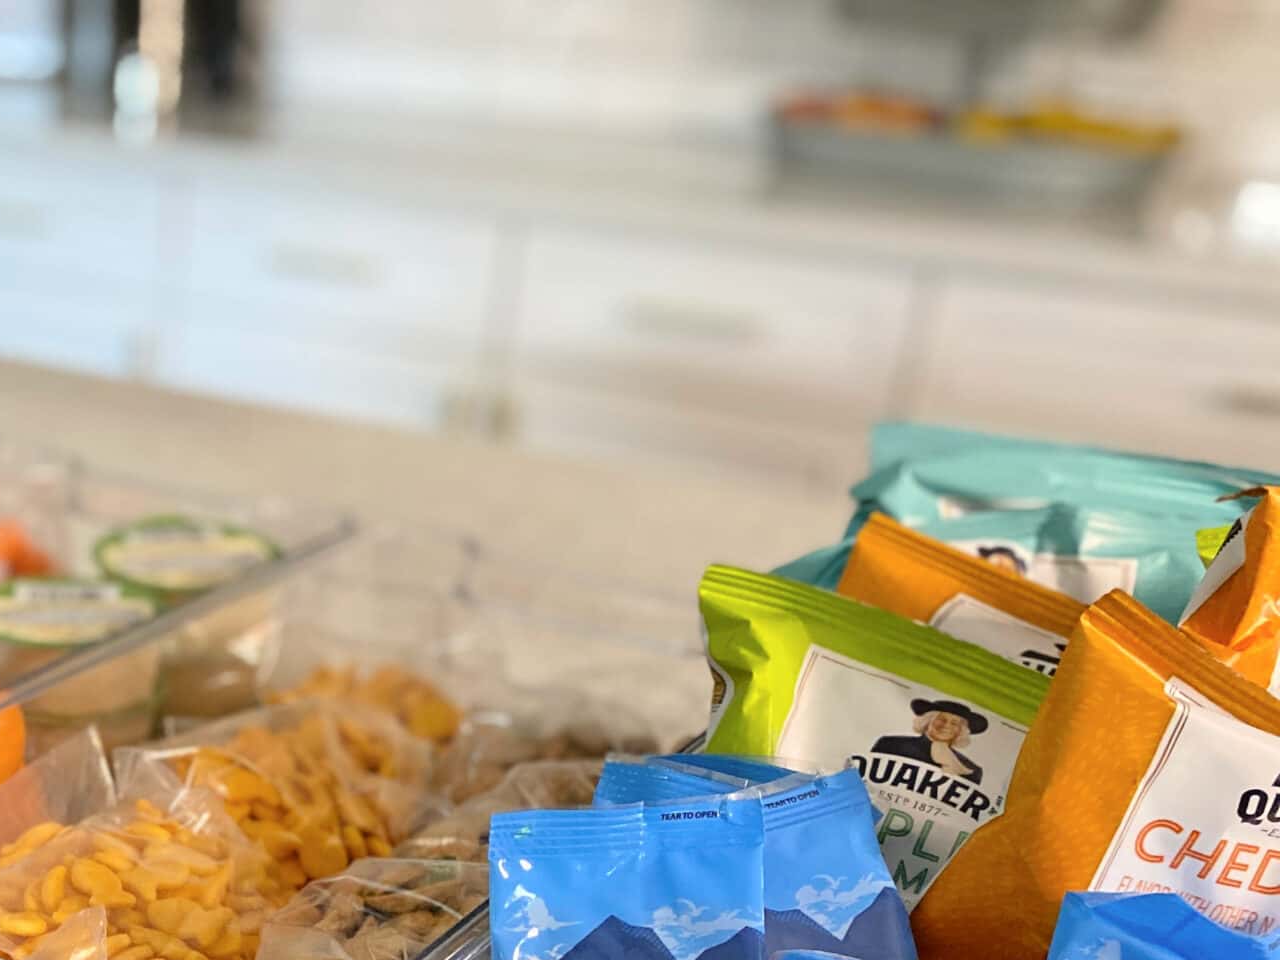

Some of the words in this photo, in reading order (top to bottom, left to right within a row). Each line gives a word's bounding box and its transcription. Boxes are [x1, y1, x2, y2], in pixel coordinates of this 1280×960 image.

[764, 798, 785, 810] TEAR
[785, 796, 797, 806] TO
[798, 789, 820, 802] OPEN
[661, 812, 682, 821] TEAR
[682, 811, 694, 820] TO
[695, 810, 718, 820] OPEN
